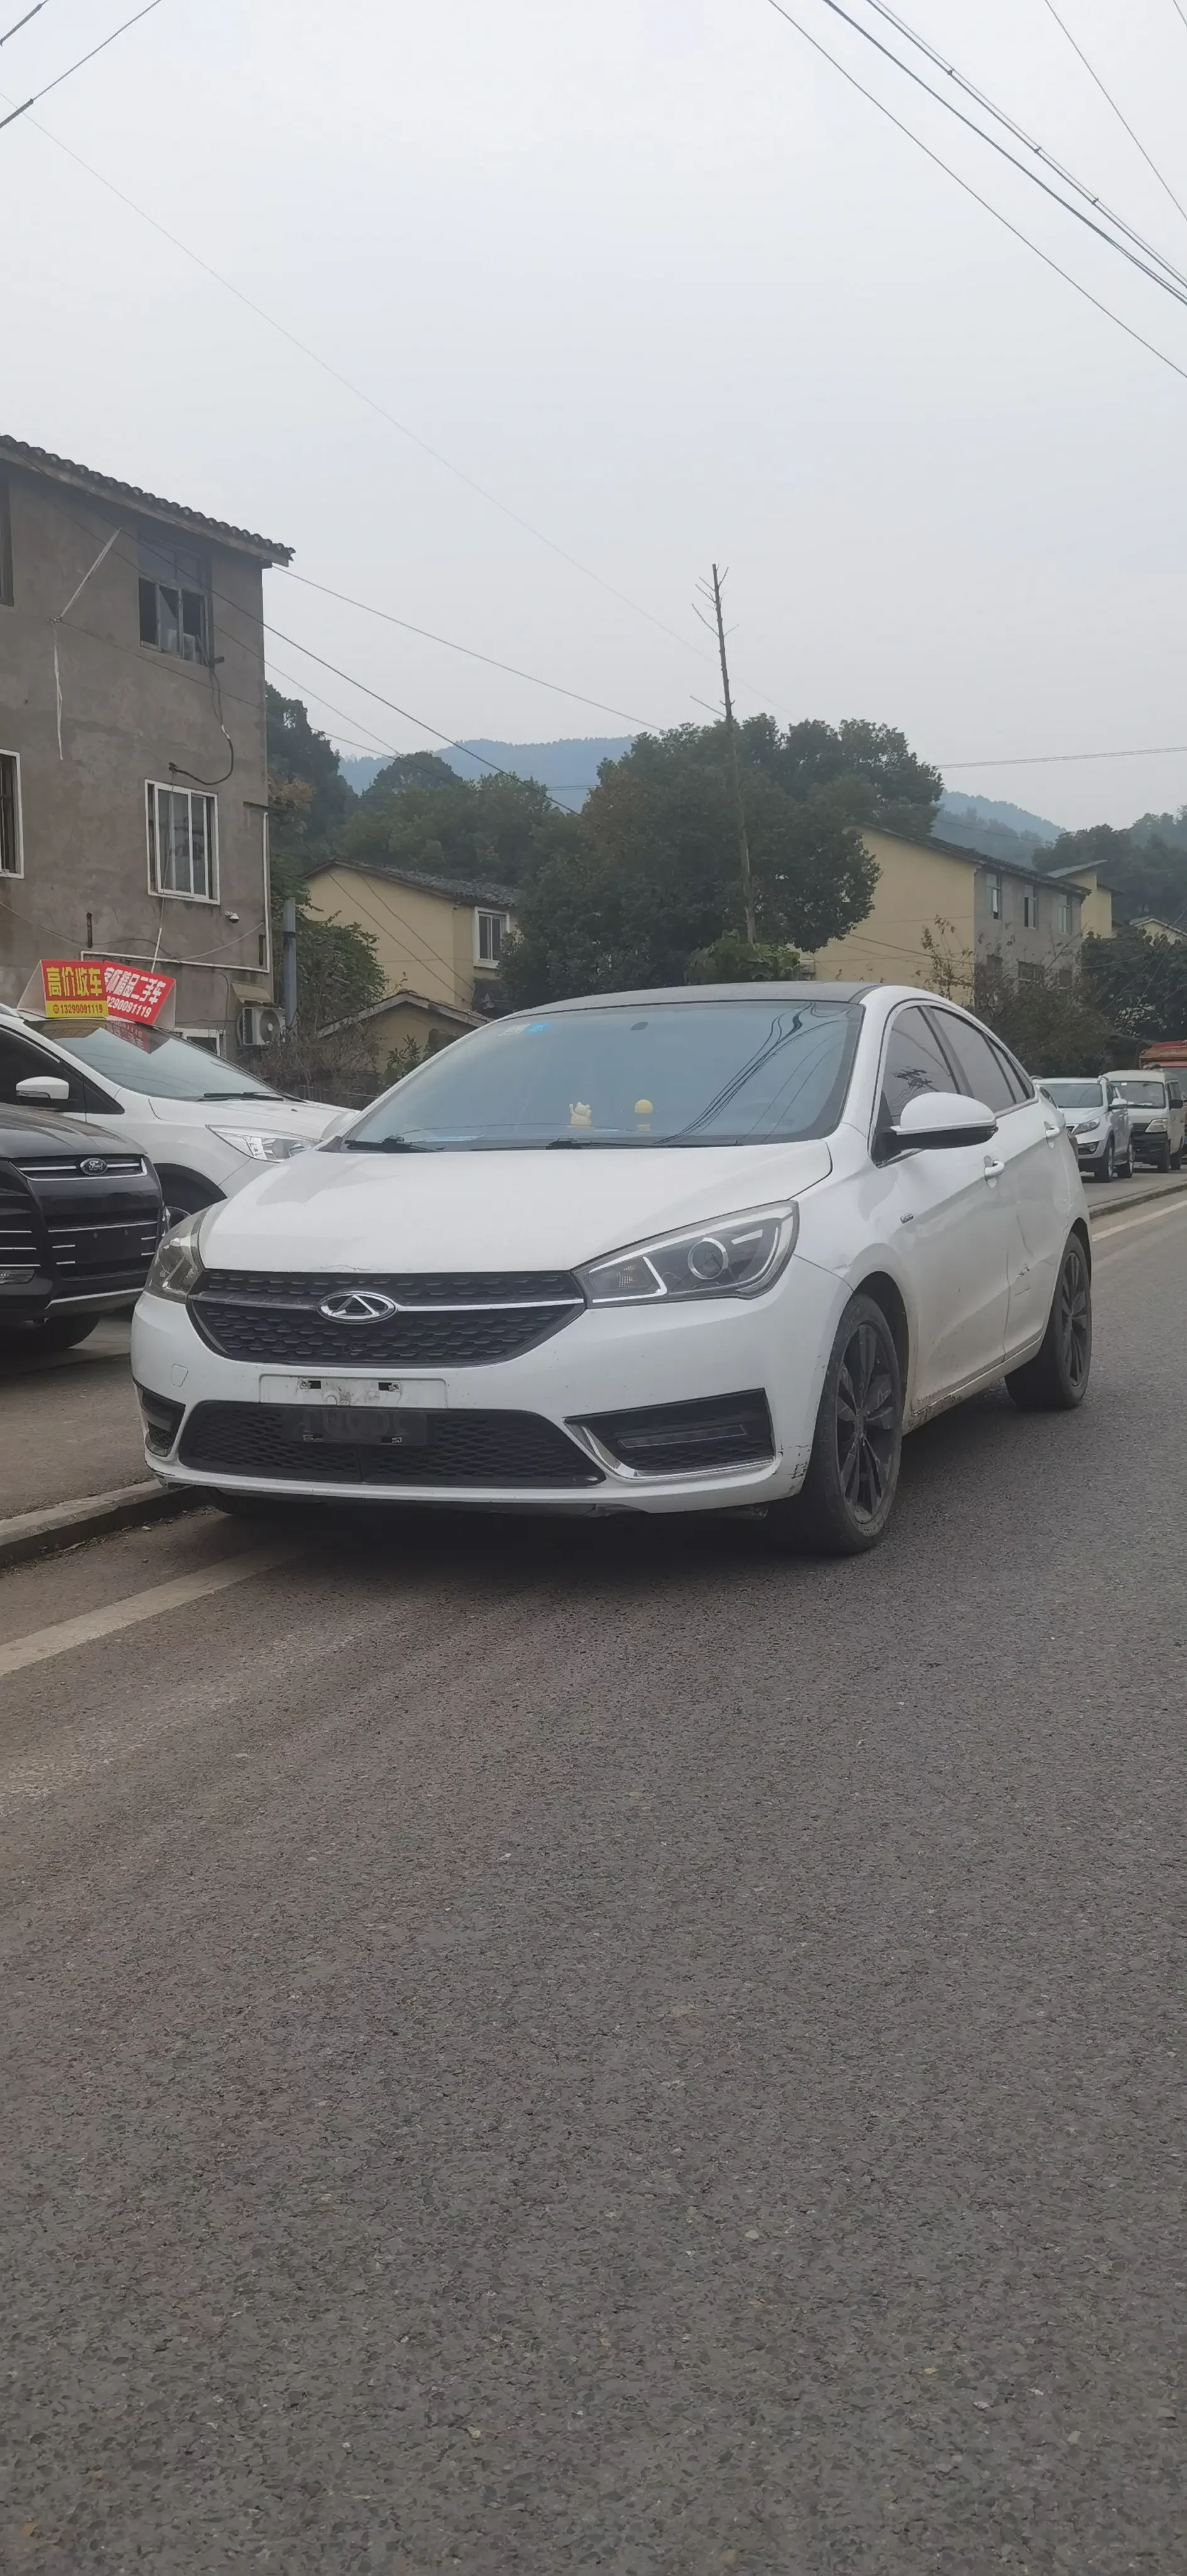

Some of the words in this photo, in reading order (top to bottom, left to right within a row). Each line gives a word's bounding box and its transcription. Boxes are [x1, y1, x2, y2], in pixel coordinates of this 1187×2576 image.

[47, 967, 102, 997] 高价收车
[60, 1004, 102, 1014] 13290091119
